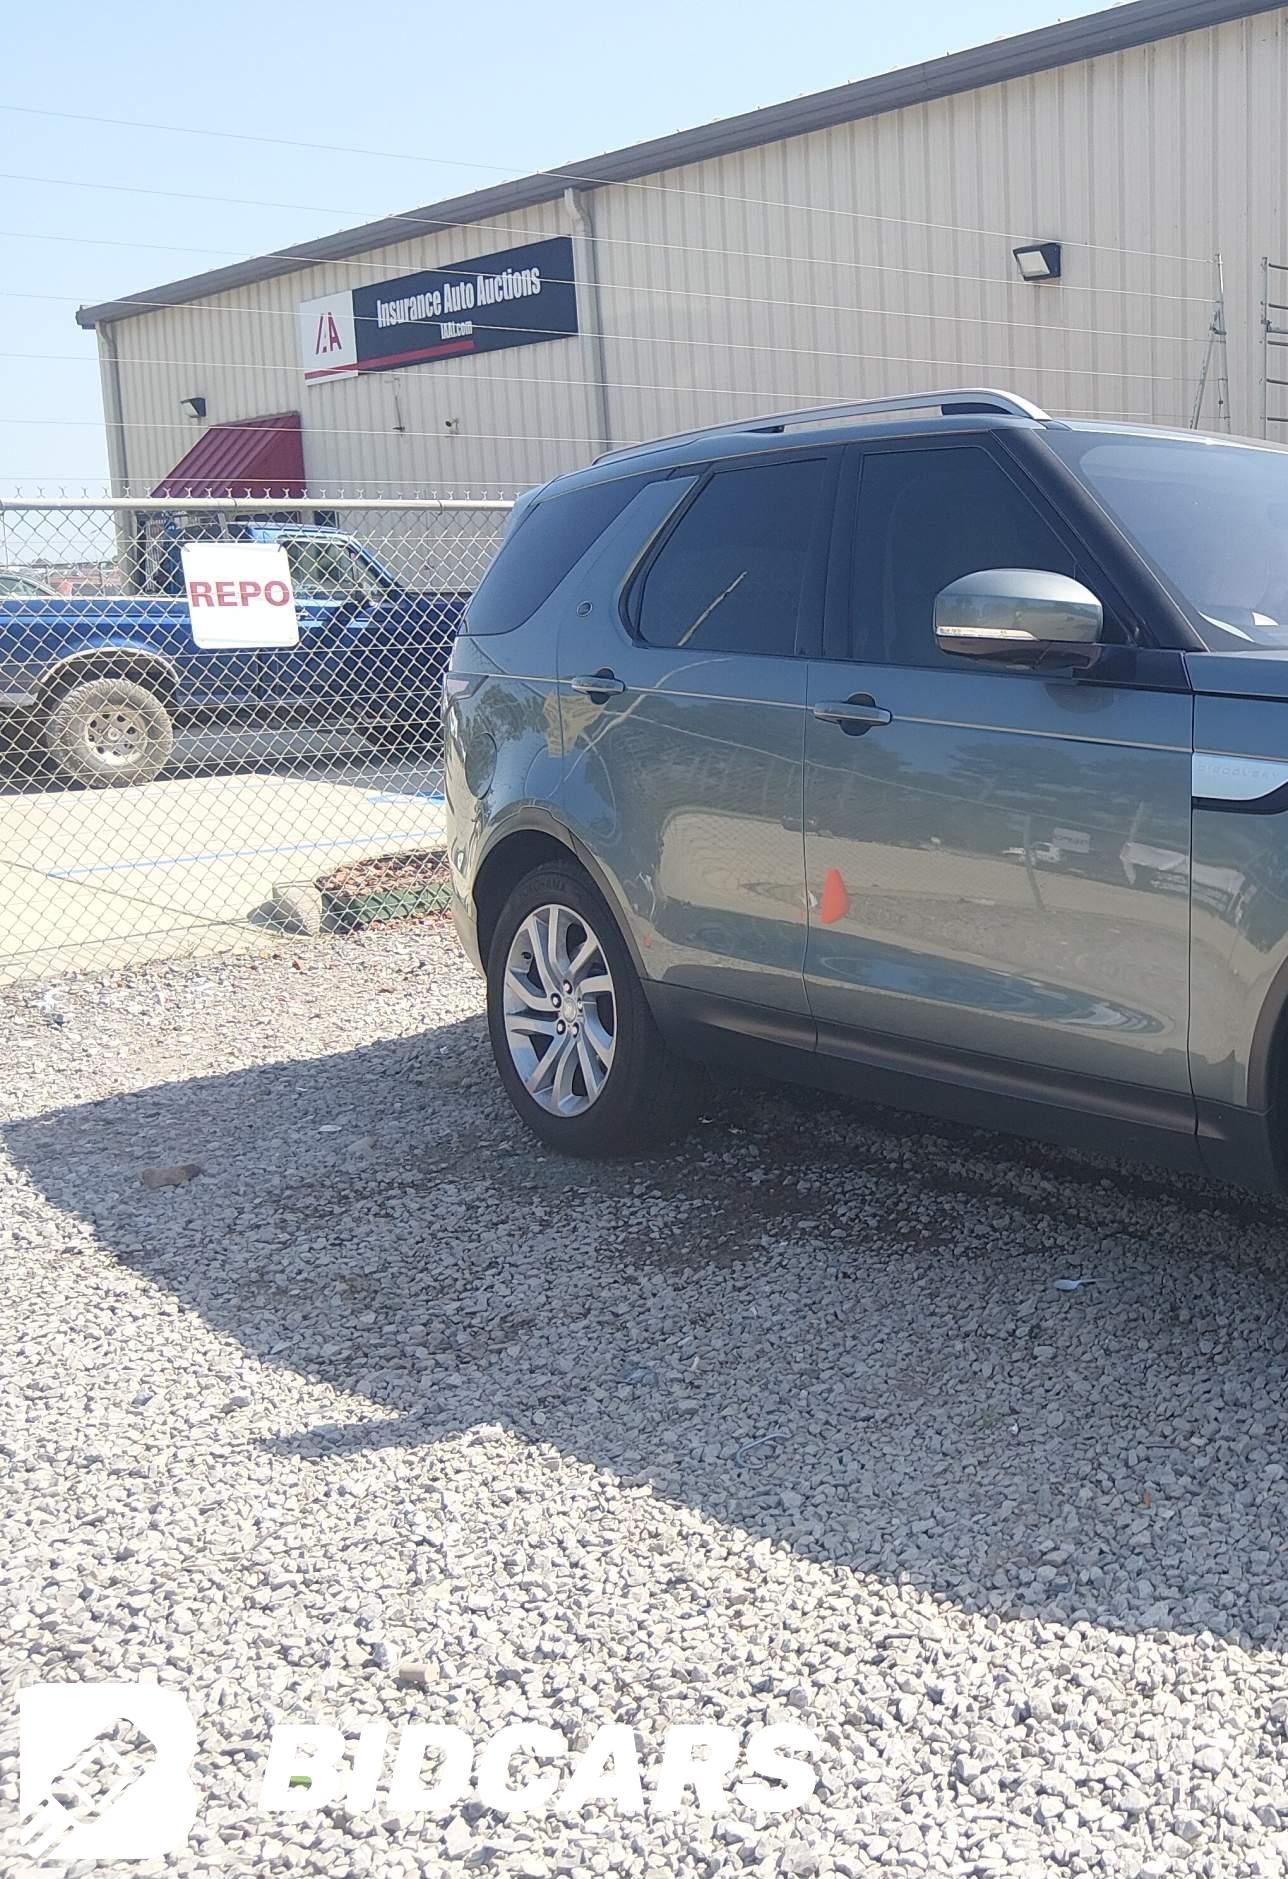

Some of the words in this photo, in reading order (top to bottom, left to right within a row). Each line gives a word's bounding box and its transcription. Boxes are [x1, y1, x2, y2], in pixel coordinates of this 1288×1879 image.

[377, 290, 442, 328] Insurance
[443, 281, 475, 313] Auto
[476, 267, 542, 306] Auctions
[189, 580, 290, 607] REPO
